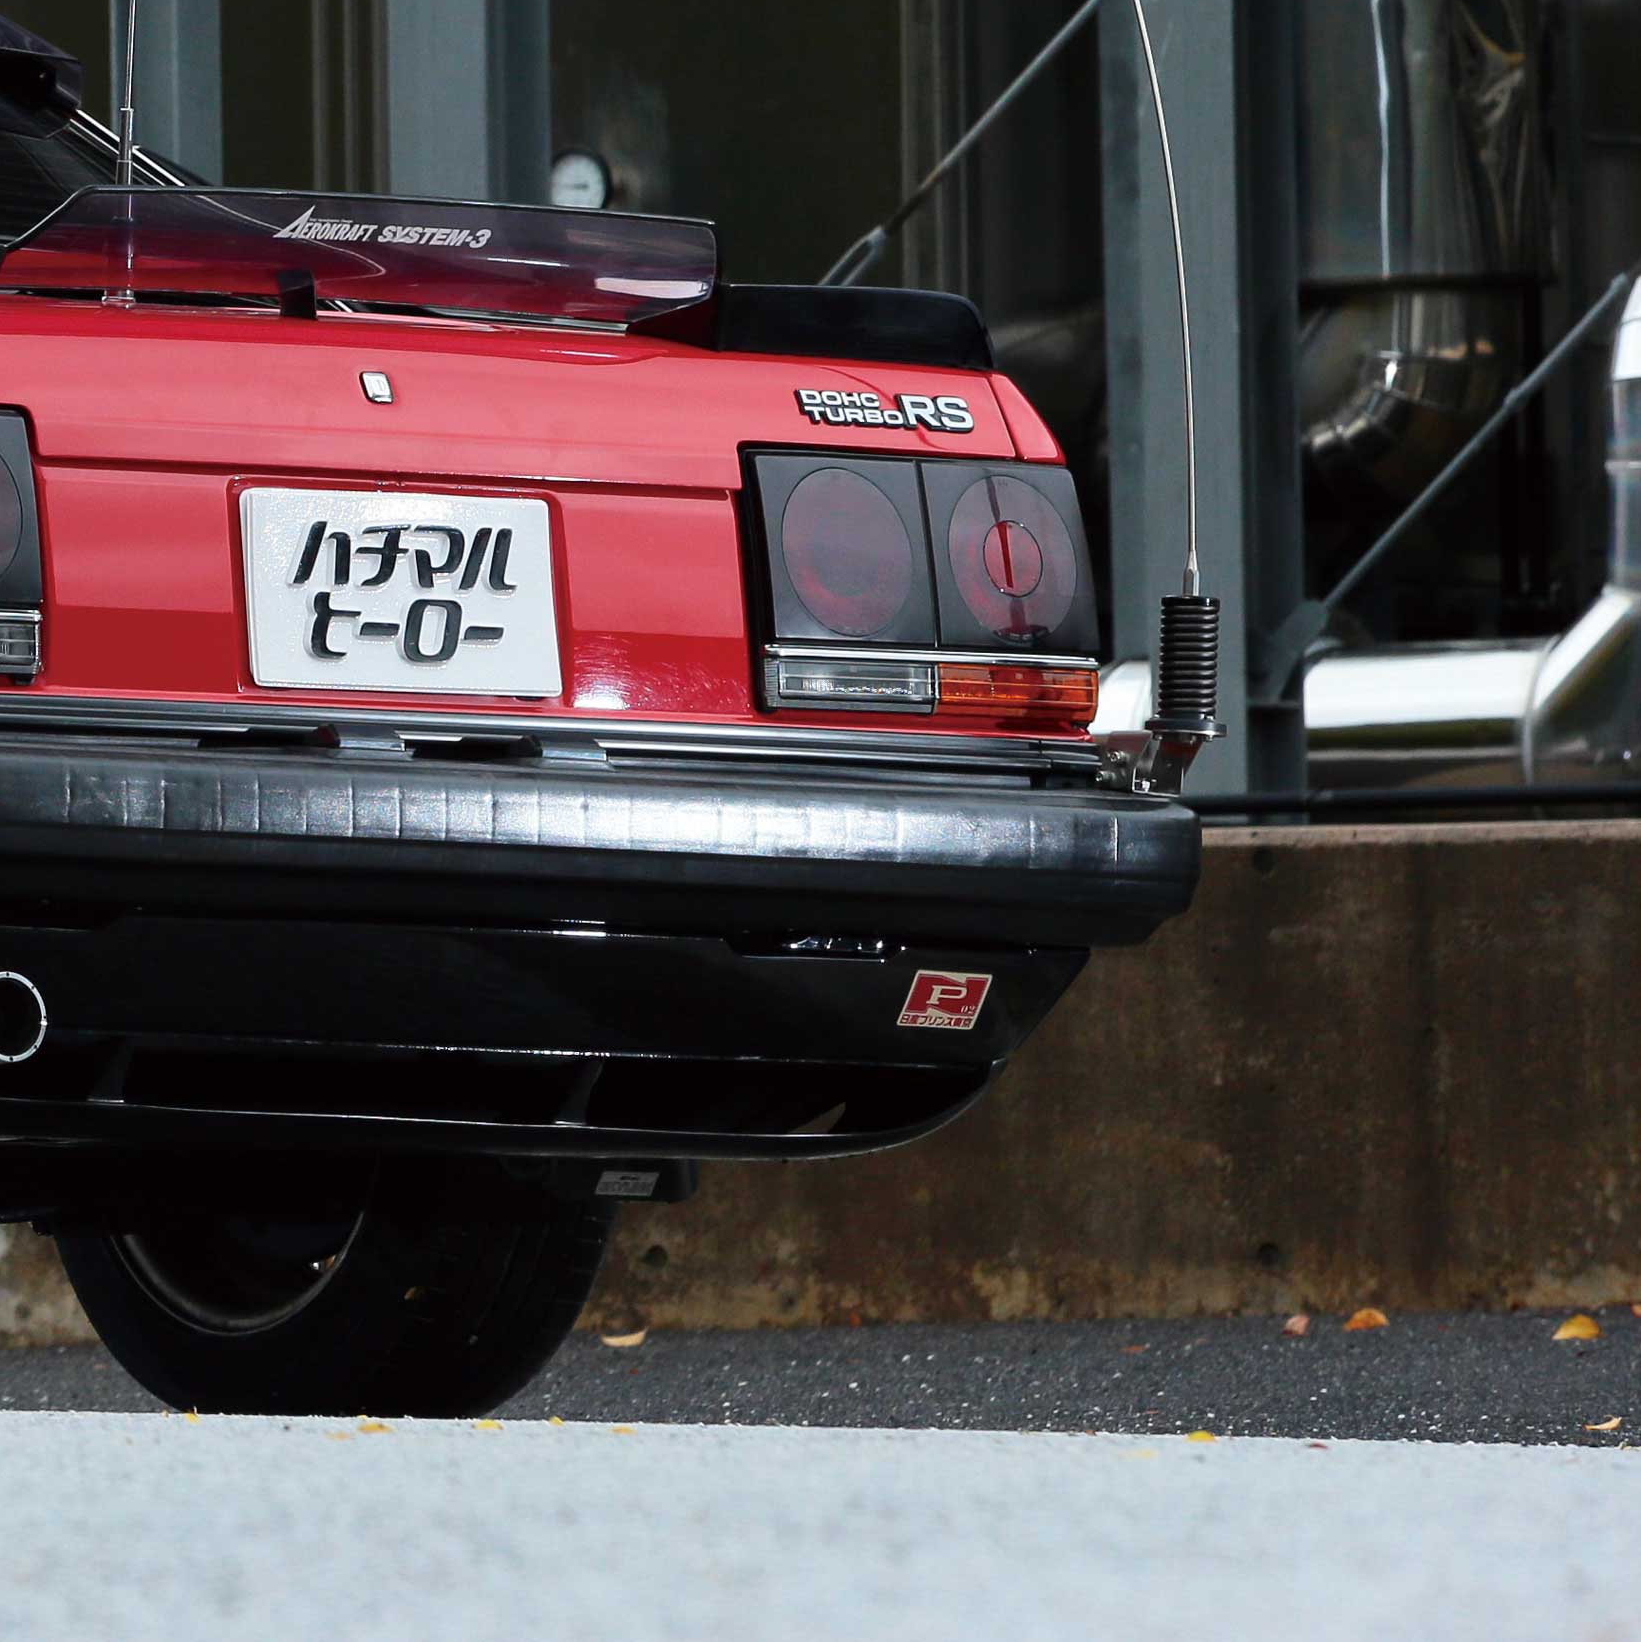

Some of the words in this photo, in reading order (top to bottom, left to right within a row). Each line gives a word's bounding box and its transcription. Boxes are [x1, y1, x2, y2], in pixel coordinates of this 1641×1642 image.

[273, 205, 377, 242] AEROKRAFT
[797, 389, 881, 409] DOHC
[803, 405, 905, 426] TURBO
[898, 394, 974, 429] RS
[291, 521, 517, 591] ハチマル
[310, 592, 505, 664] ヒーロー
[926, 984, 968, 1005] P
